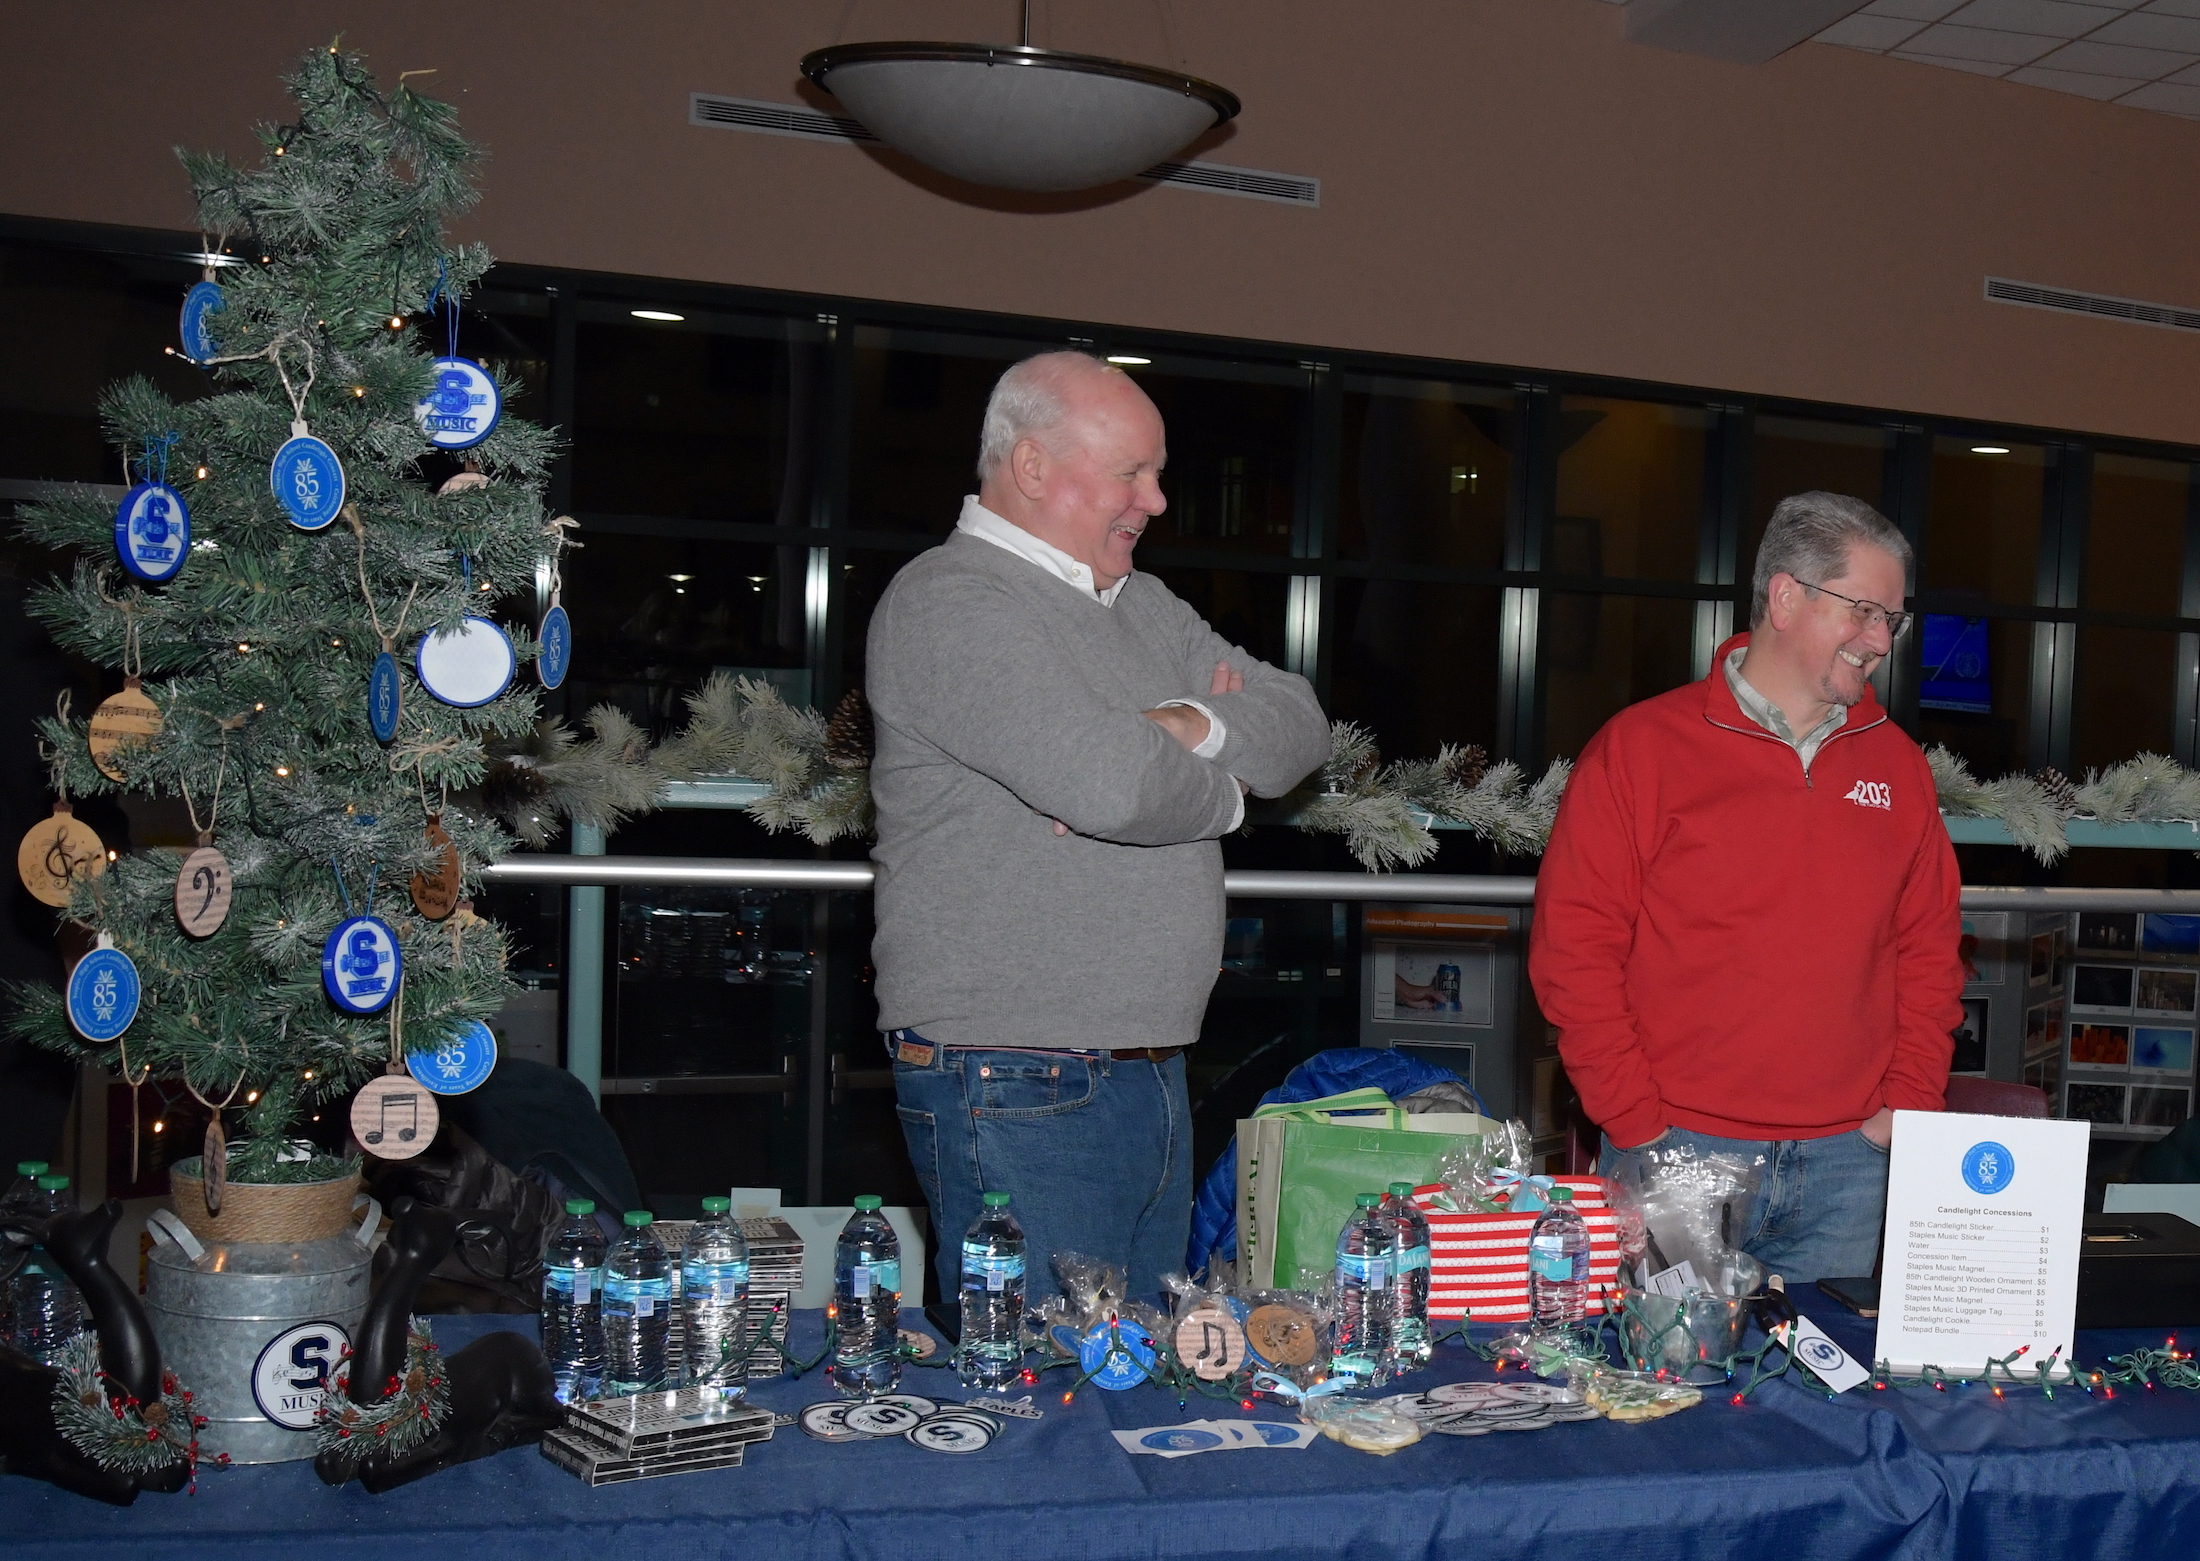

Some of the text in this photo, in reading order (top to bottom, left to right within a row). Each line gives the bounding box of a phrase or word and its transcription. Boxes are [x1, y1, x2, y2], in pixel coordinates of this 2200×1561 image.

[437, 369, 473, 415] S
[426, 417, 477, 430] MUSIC
[295, 472, 319, 496] 85
[142, 494, 170, 546] S
[550, 638, 561, 660] 85
[378, 687, 391, 710] 85
[1856, 779, 1891, 807] 203
[1366, 918, 1435, 928] Advanced Photography
[348, 928, 379, 979] S
[93, 984, 117, 1007] 85
[480, 1033, 490, 1056] Concert
[436, 1044, 466, 1066] 85
[415, 1065, 438, 1089] Excellence
[465, 1061, 490, 1087] Celebrating
[1978, 1161, 1997, 1176] 85
[1937, 1206, 2032, 1217] Candlelight Concessions
[1927, 1221, 1967, 1230] Candlelight
[1909, 1231, 1936, 1240] Staples
[1399, 1252, 1428, 1267] DASAN
[1907, 1252, 1949, 1260] Concession
[1907, 1263, 1934, 1271] Staples
[1958, 1265, 1985, 1273] Magnet
[1924, 1274, 1964, 1283] Candlelight
[1966, 1276, 1995, 1284] Wooden
[1997, 1277, 2033, 1285] Ornament
[1905, 1284, 1932, 1292] Staples
[1904, 1294, 2045, 1307] Staples Music Magnet $5
[1904, 1304, 1931, 1313] Staples
[1955, 1307, 1987, 1315] Luggage
[1903, 1315, 1943, 1324] Candlelight
[1902, 1326, 1933, 1334] Notepad
[1804, 1348, 1824, 1365] MUSIC
[1812, 1343, 1836, 1359] S
[288, 1334, 331, 1392] S
[868, 1408, 908, 1424] S
[855, 1419, 889, 1430] MUSIC
[925, 1425, 966, 1441] S
[946, 1436, 979, 1449] MUSIC
